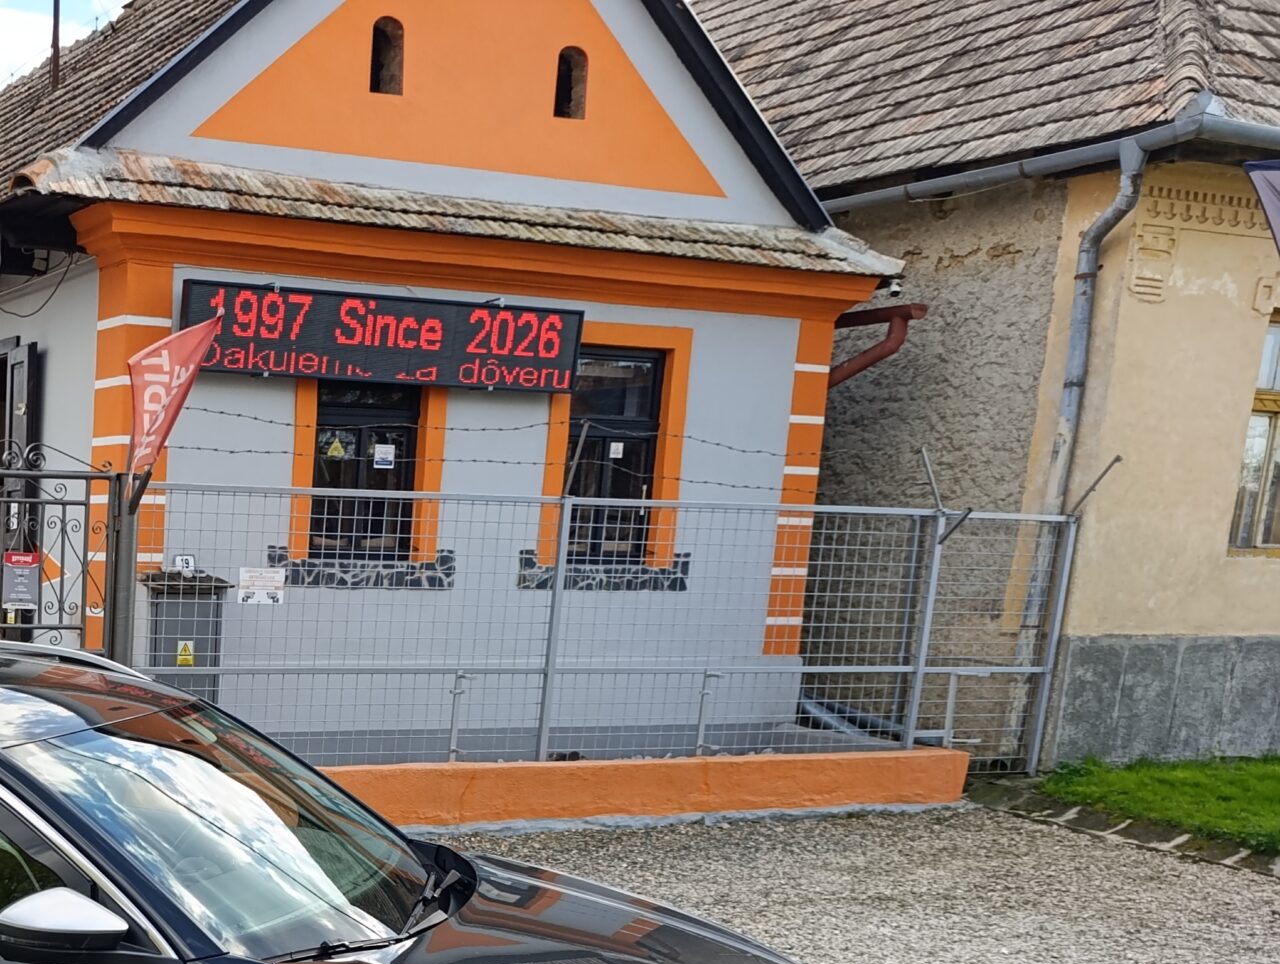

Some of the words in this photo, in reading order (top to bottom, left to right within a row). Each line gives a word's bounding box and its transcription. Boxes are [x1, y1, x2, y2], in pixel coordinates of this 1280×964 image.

[210, 288, 313, 341] 1997
[335, 297, 443, 351] Since
[465, 307, 563, 359] 2026
[458, 357, 572, 390] dôveru
